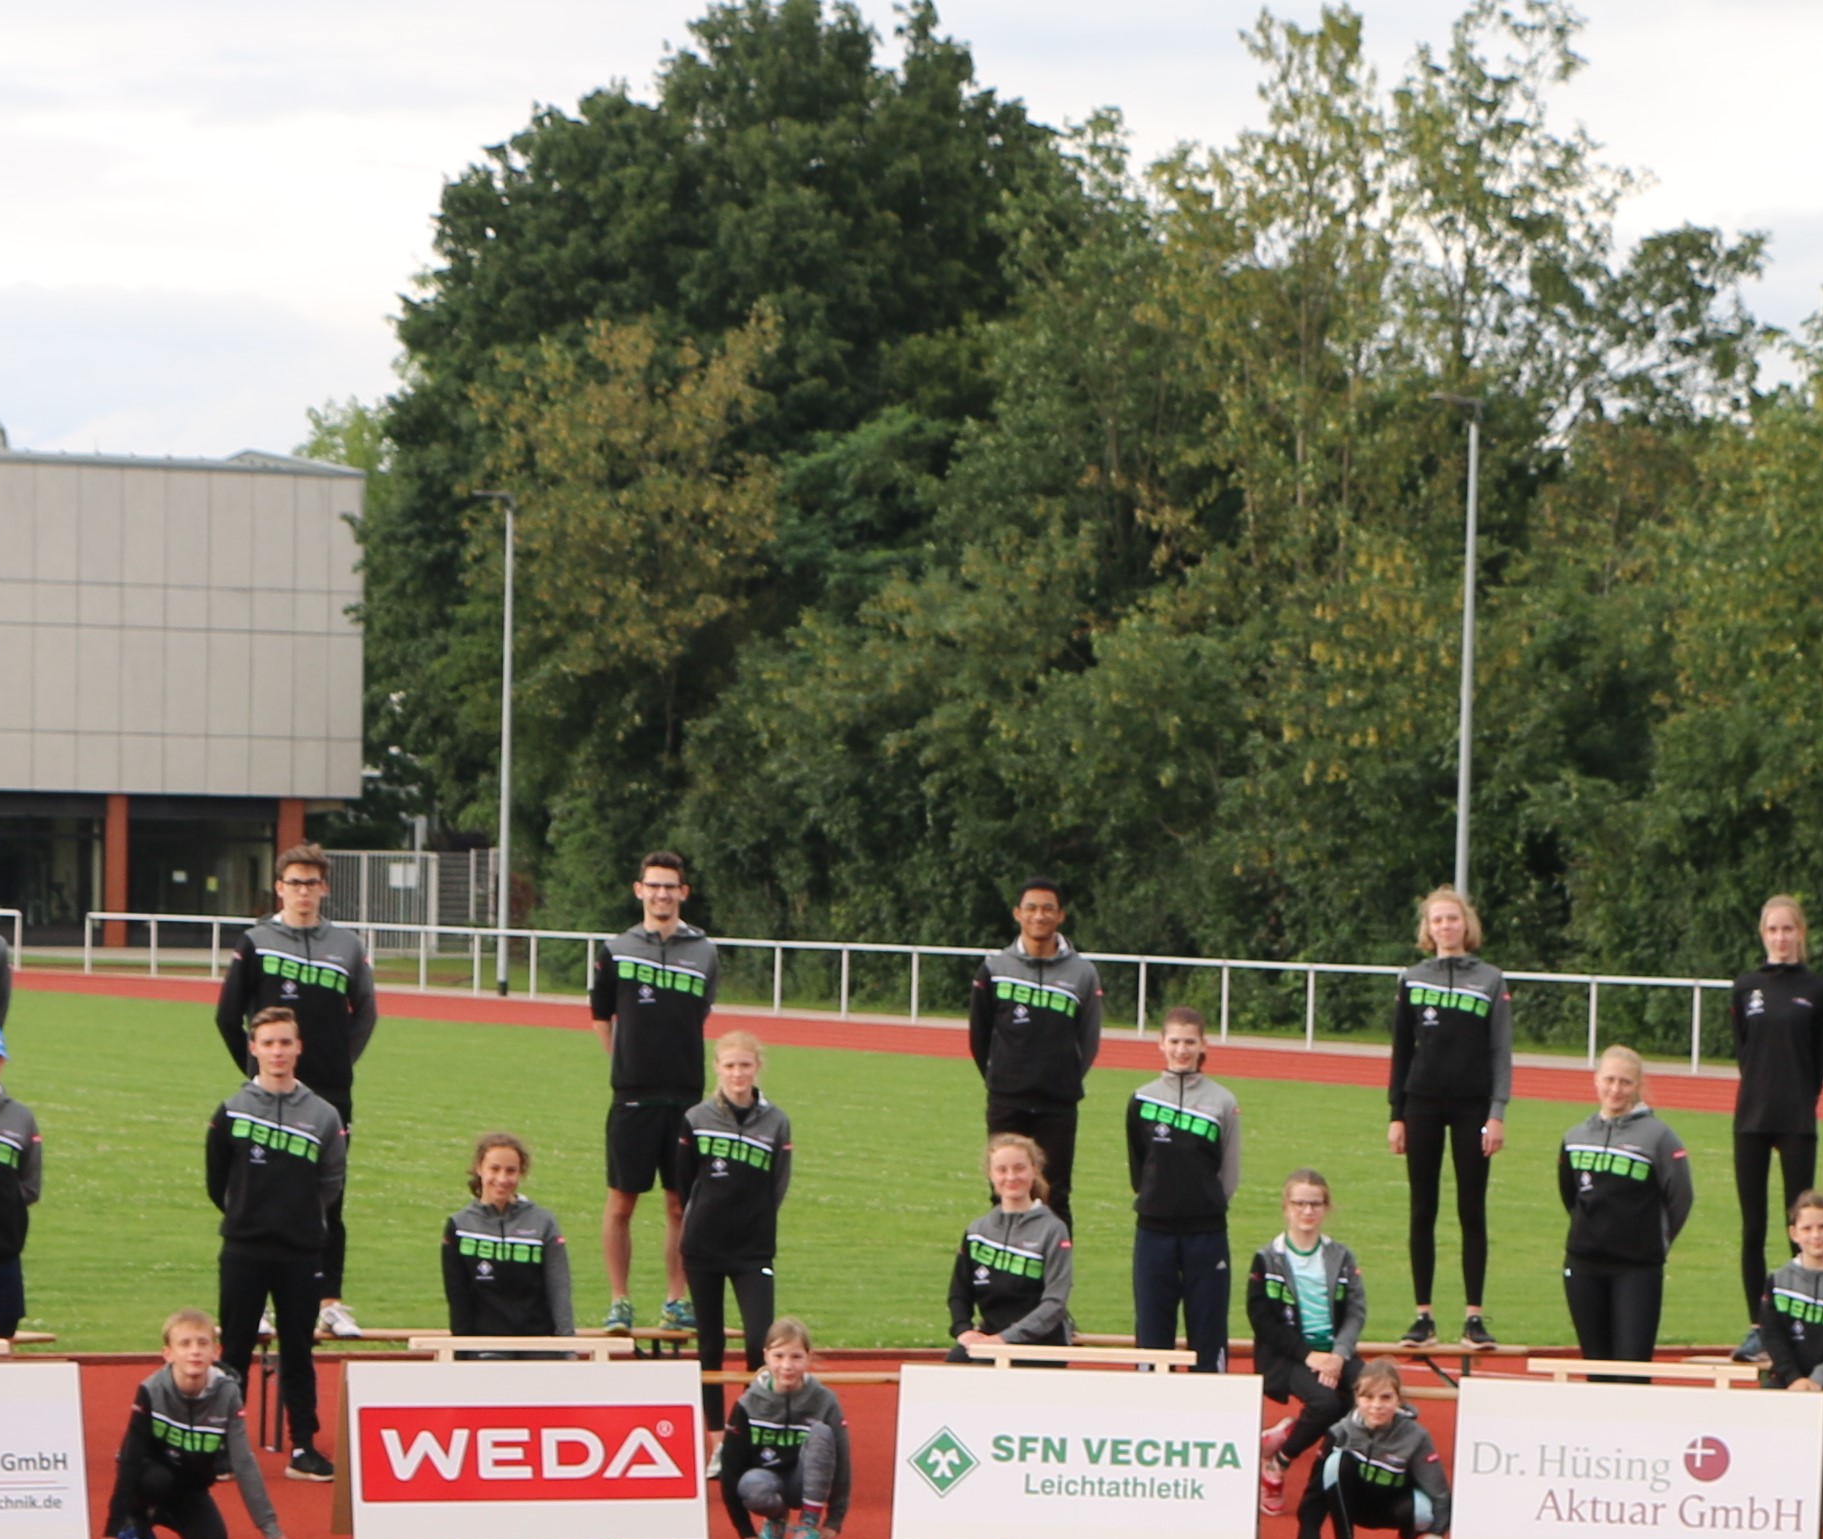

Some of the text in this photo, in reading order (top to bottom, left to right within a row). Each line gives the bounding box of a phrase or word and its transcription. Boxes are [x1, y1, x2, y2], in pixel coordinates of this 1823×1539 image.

[0, 1452, 68, 1472] GmbH
[991, 1434, 1242, 1469] SFN VECHTA
[1471, 1441, 1672, 1493] Dr. Hüsing
[1024, 1473, 1205, 1500] Leichtathletik
[1535, 1488, 1804, 1532] Aktuar GmbH
